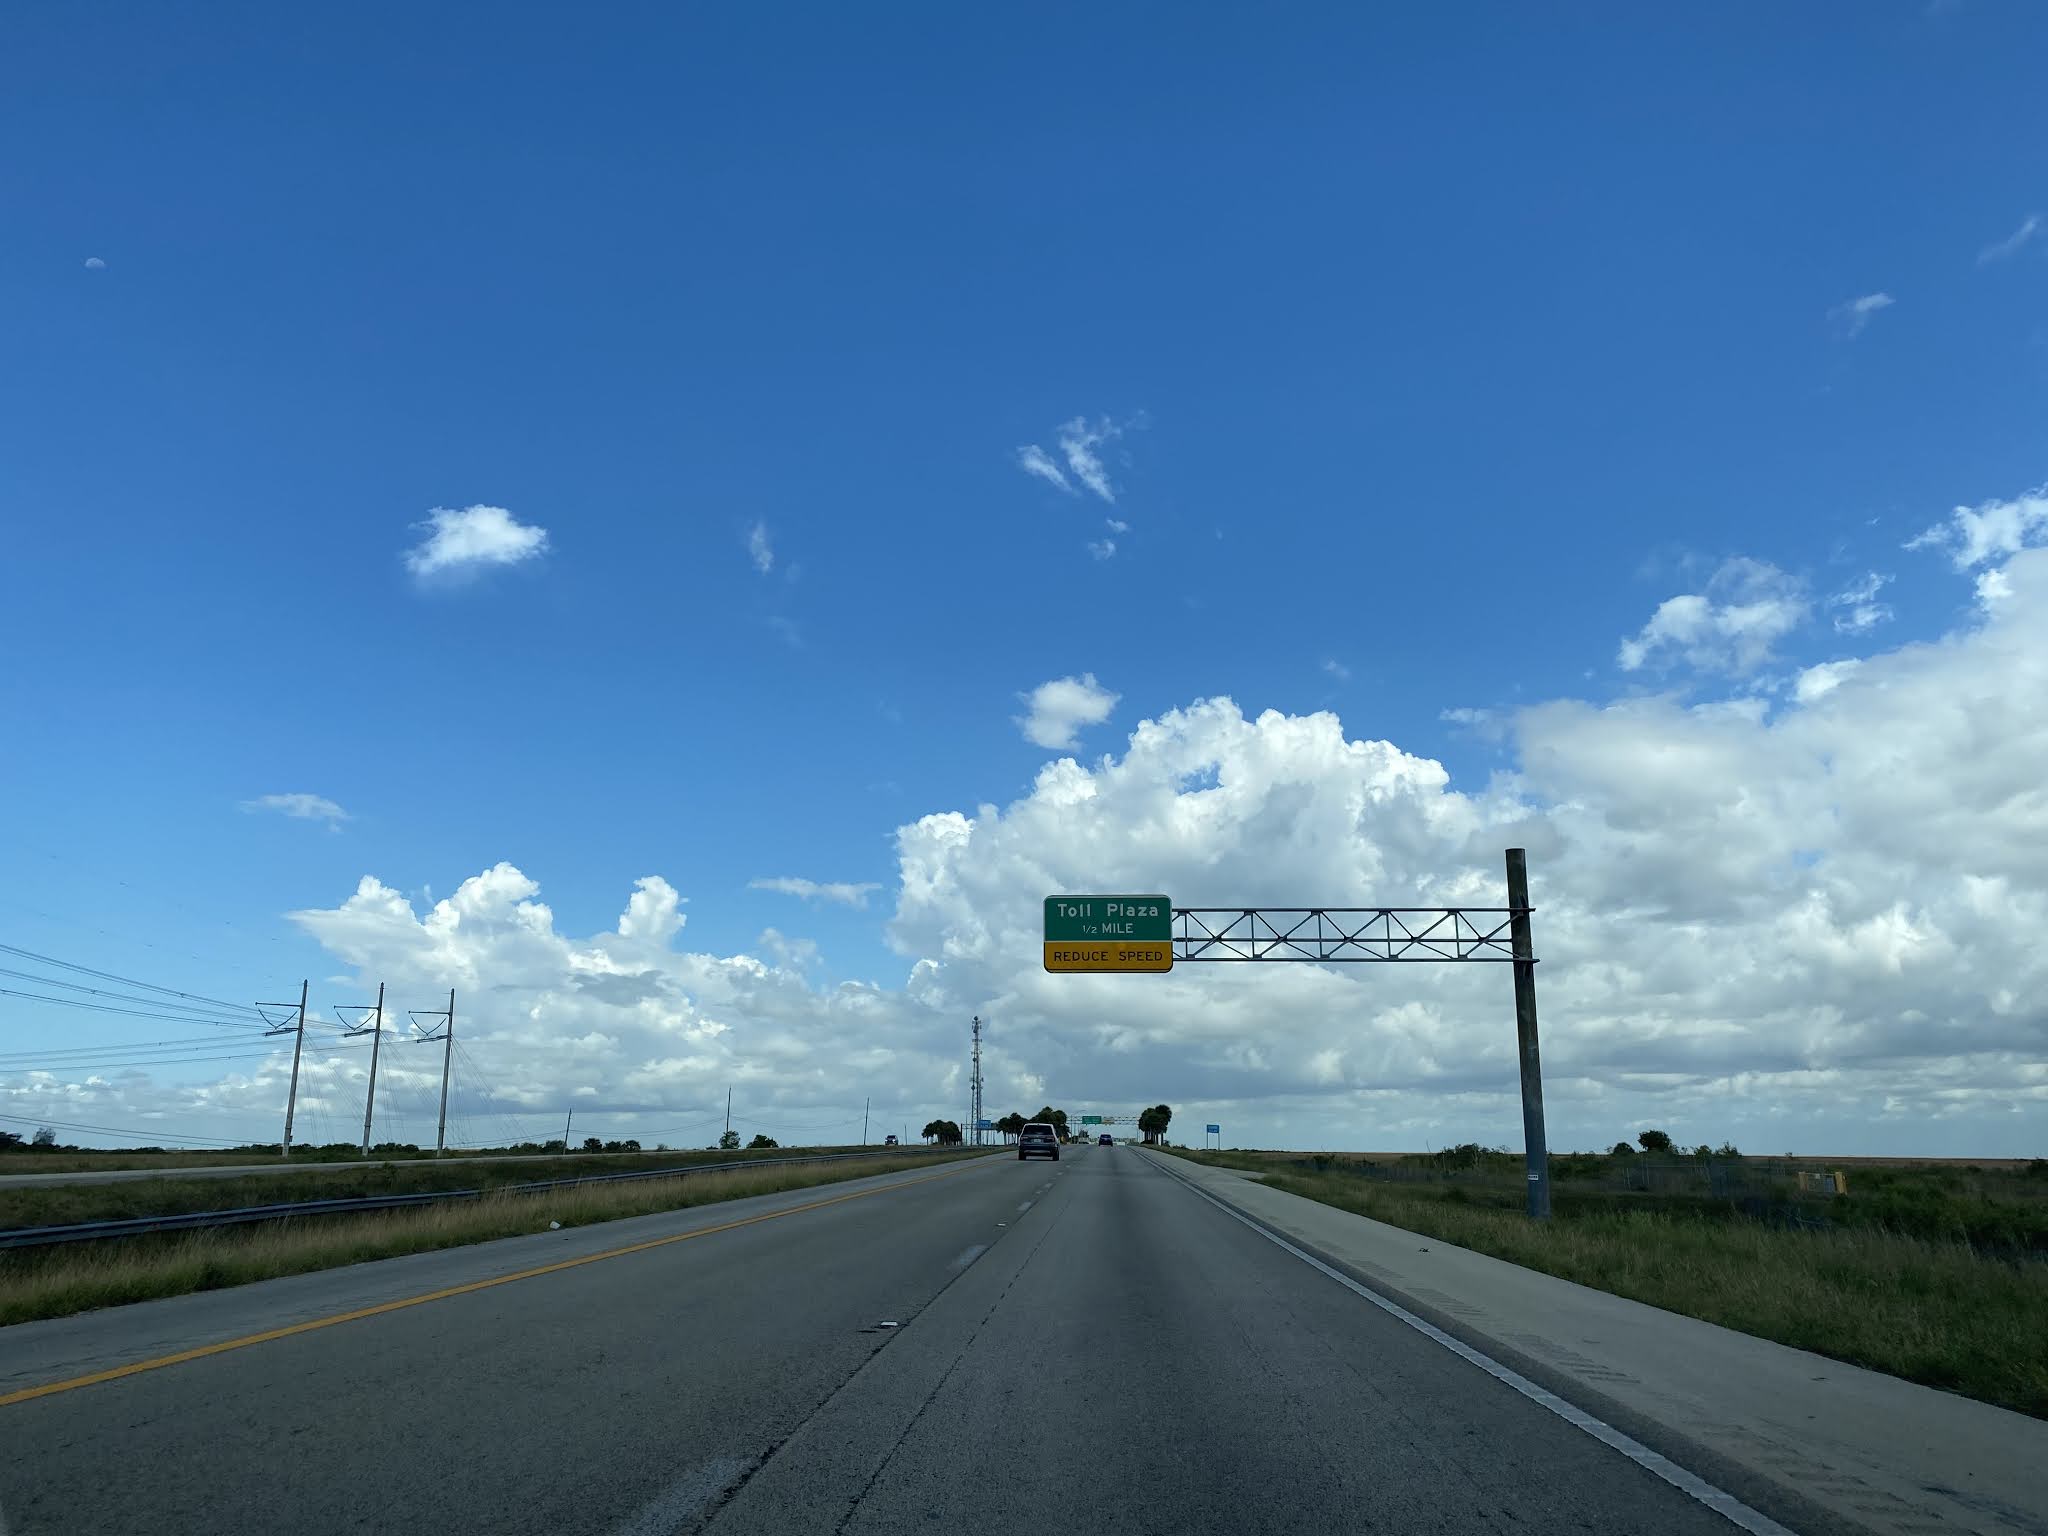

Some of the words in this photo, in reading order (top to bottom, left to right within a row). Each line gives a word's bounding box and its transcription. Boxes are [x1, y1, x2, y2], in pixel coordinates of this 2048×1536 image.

[1057, 903, 1091, 917] Toll
[1106, 903, 1159, 917] Plaza
[1102, 923, 1134, 934] MILE
[1053, 951, 1109, 962] REDUCE
[1118, 951, 1163, 961] SPEED
